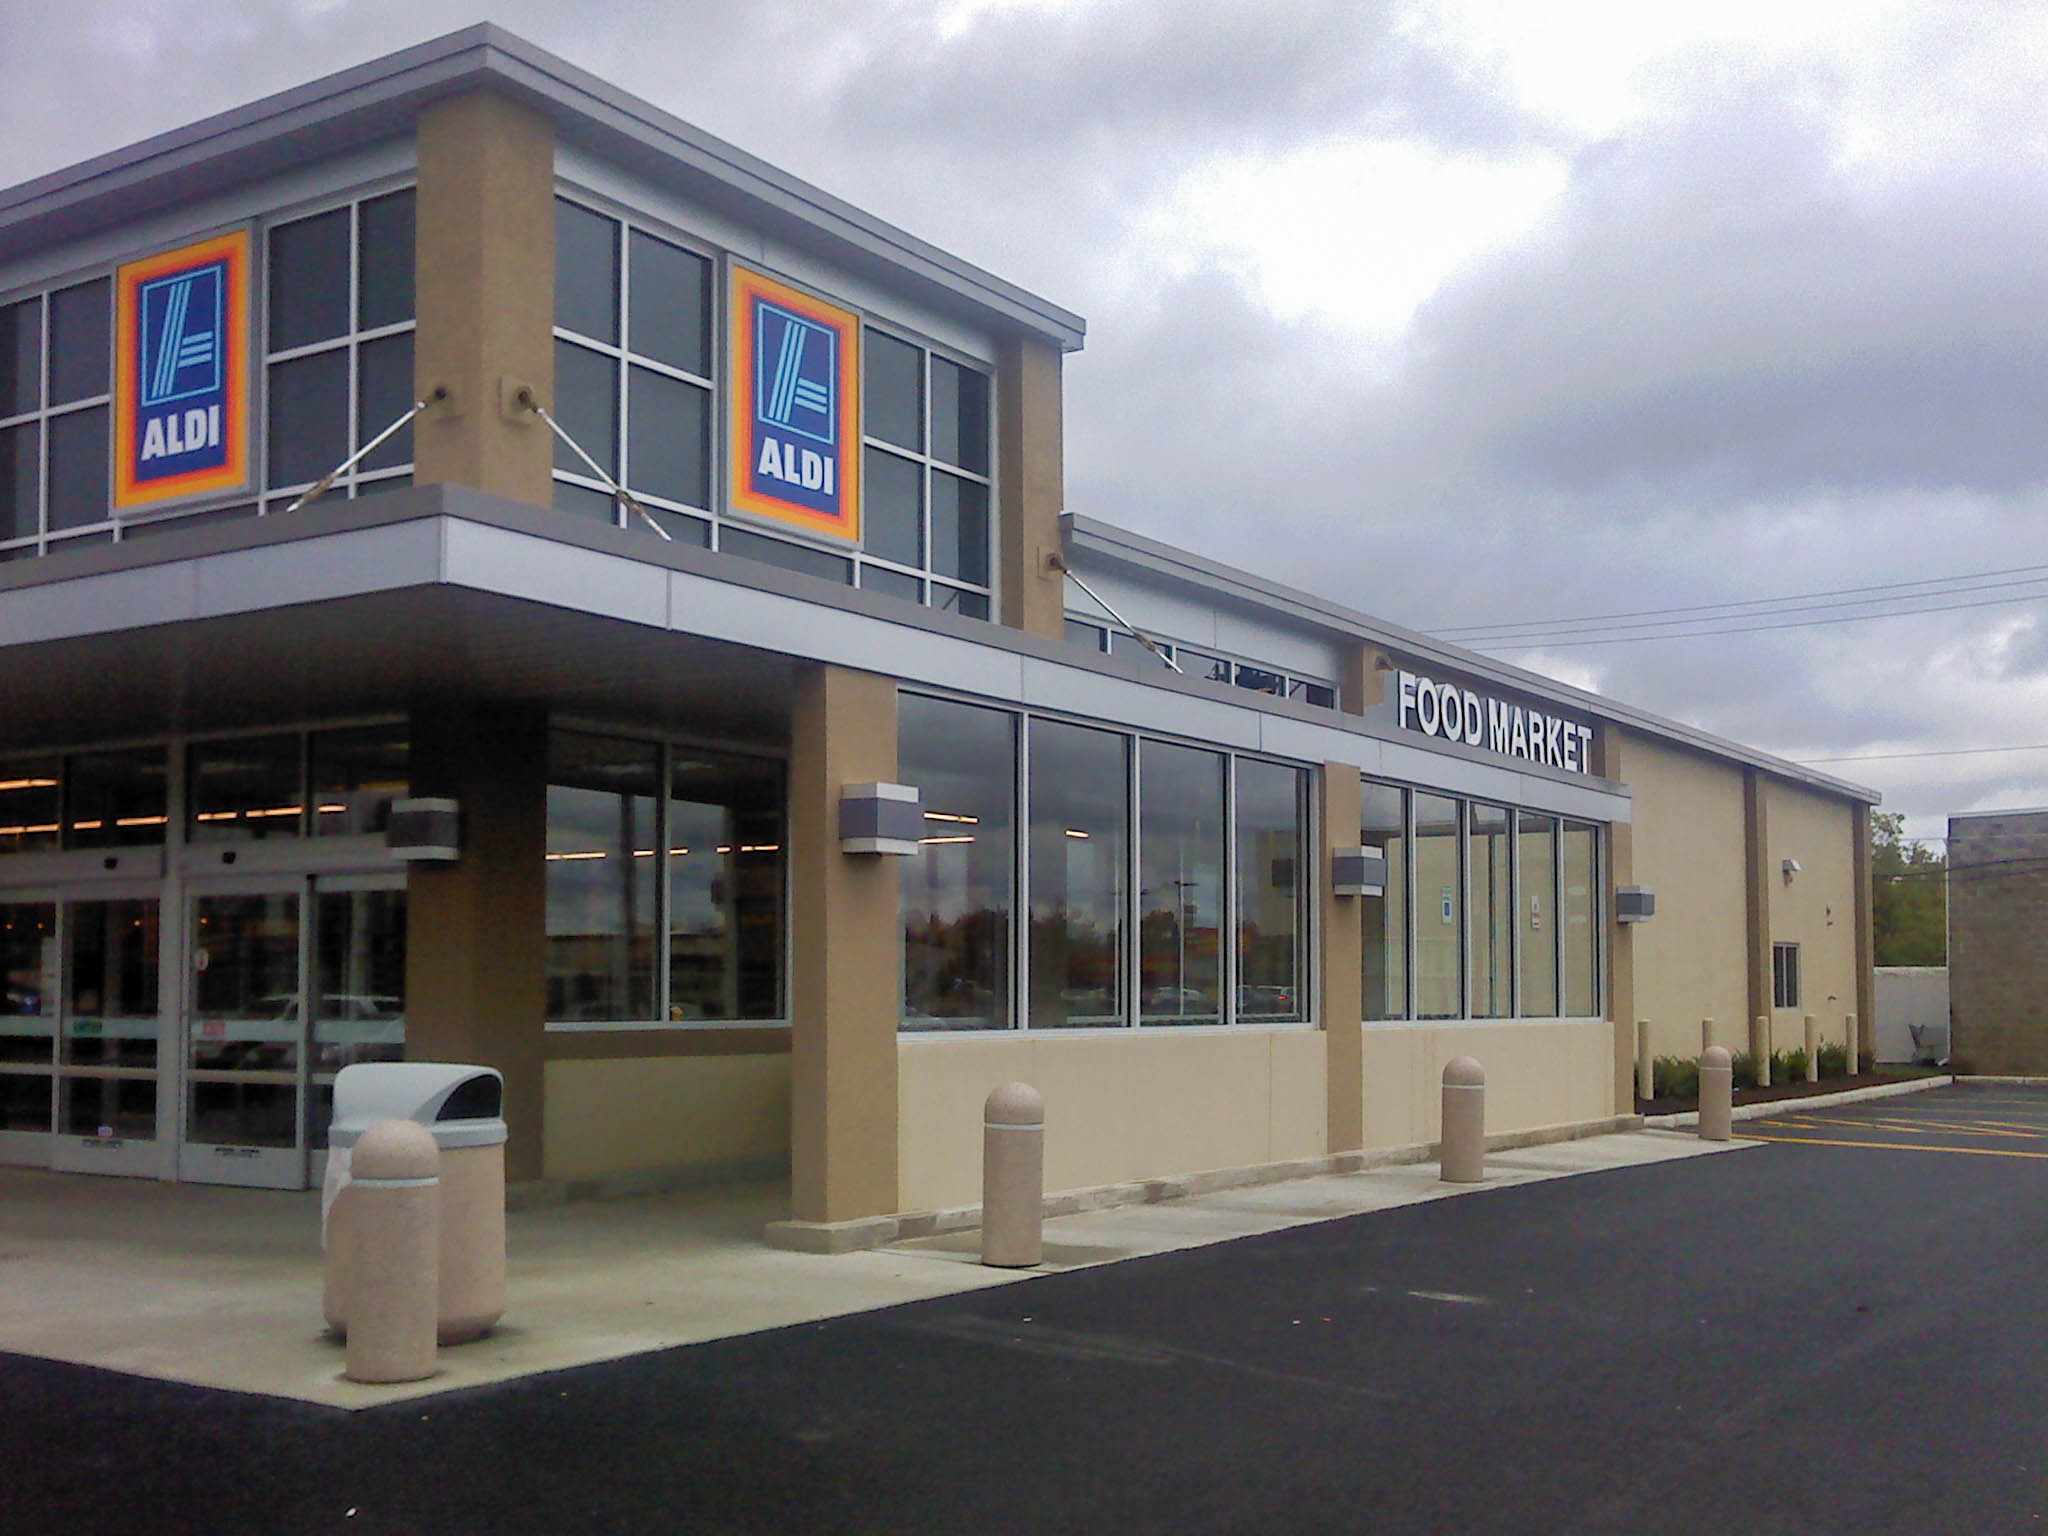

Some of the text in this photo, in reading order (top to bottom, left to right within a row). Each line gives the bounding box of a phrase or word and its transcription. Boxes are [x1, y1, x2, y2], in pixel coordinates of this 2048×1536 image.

[141, 404, 220, 461] ALDI
[758, 436, 834, 496] ALDI
[1398, 670, 1593, 774] FOOD MARKET
